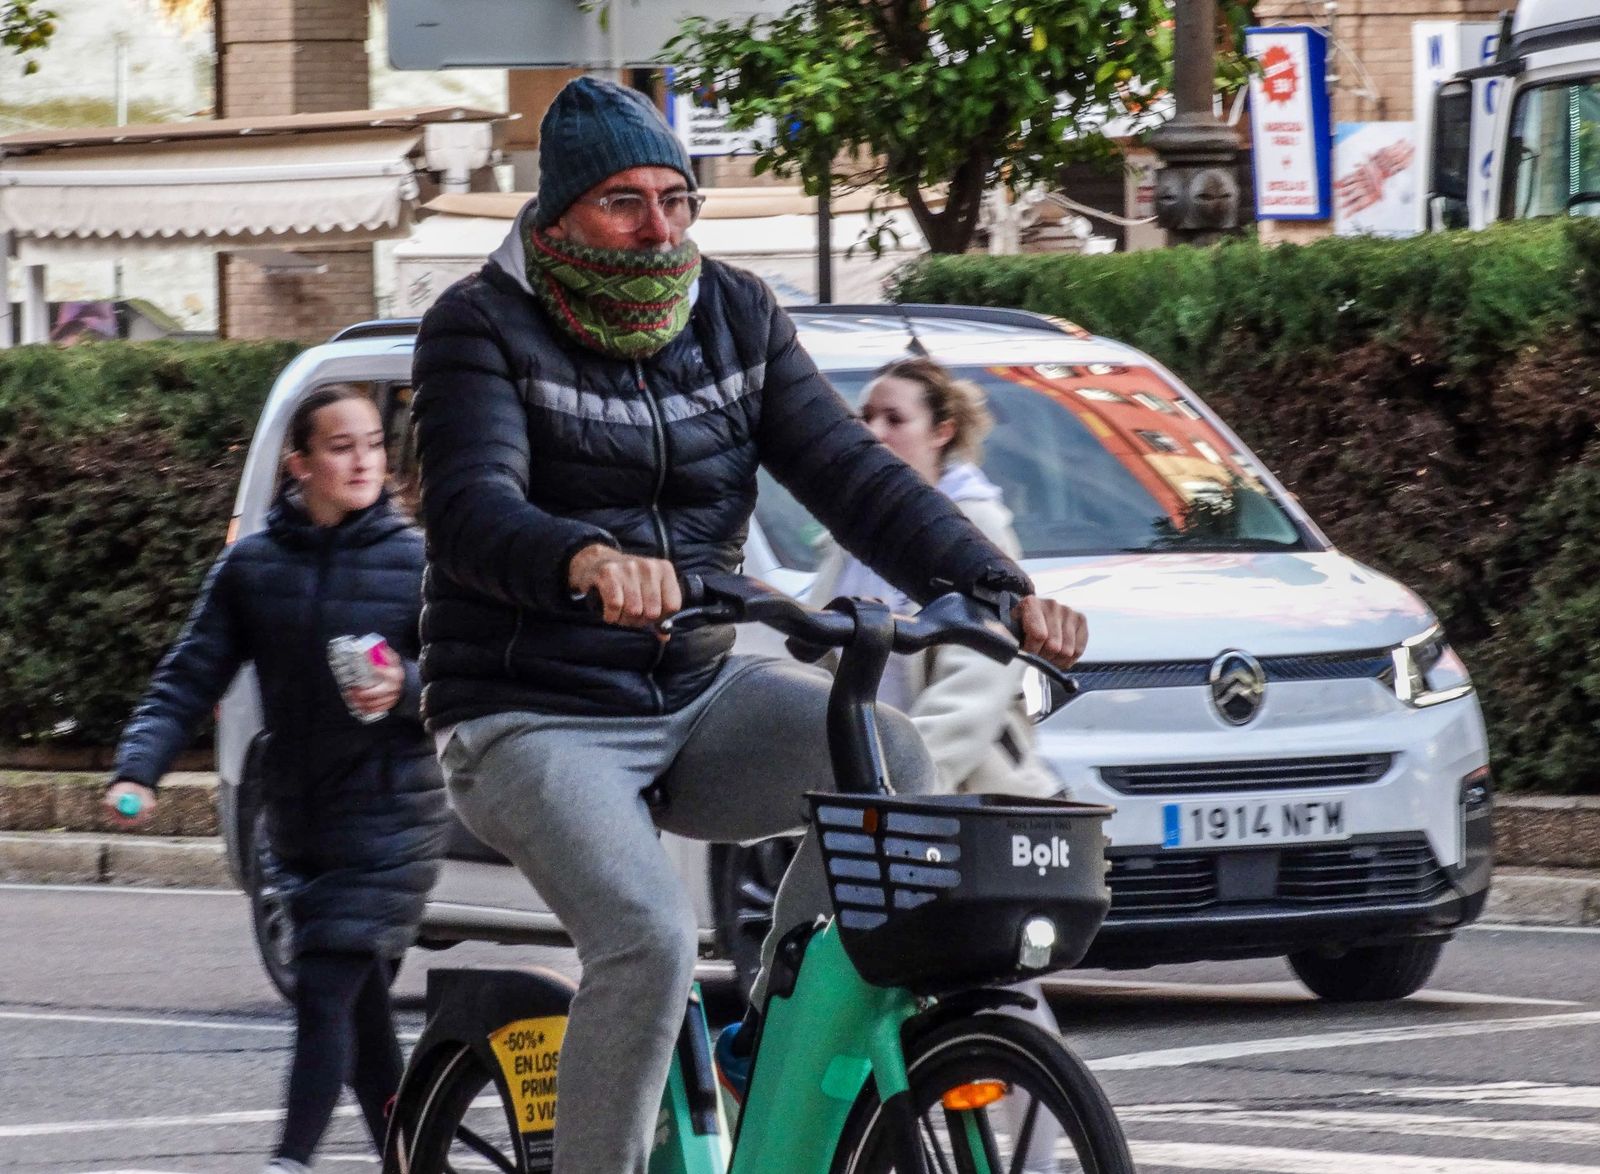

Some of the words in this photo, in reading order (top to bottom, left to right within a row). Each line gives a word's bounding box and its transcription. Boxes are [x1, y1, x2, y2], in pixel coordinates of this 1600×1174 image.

[1190, 805, 1272, 842] 1914
[1011, 834, 1070, 876] Bolt
[514, 1055, 533, 1075] EN
[526, 1103, 535, 1122] 3
